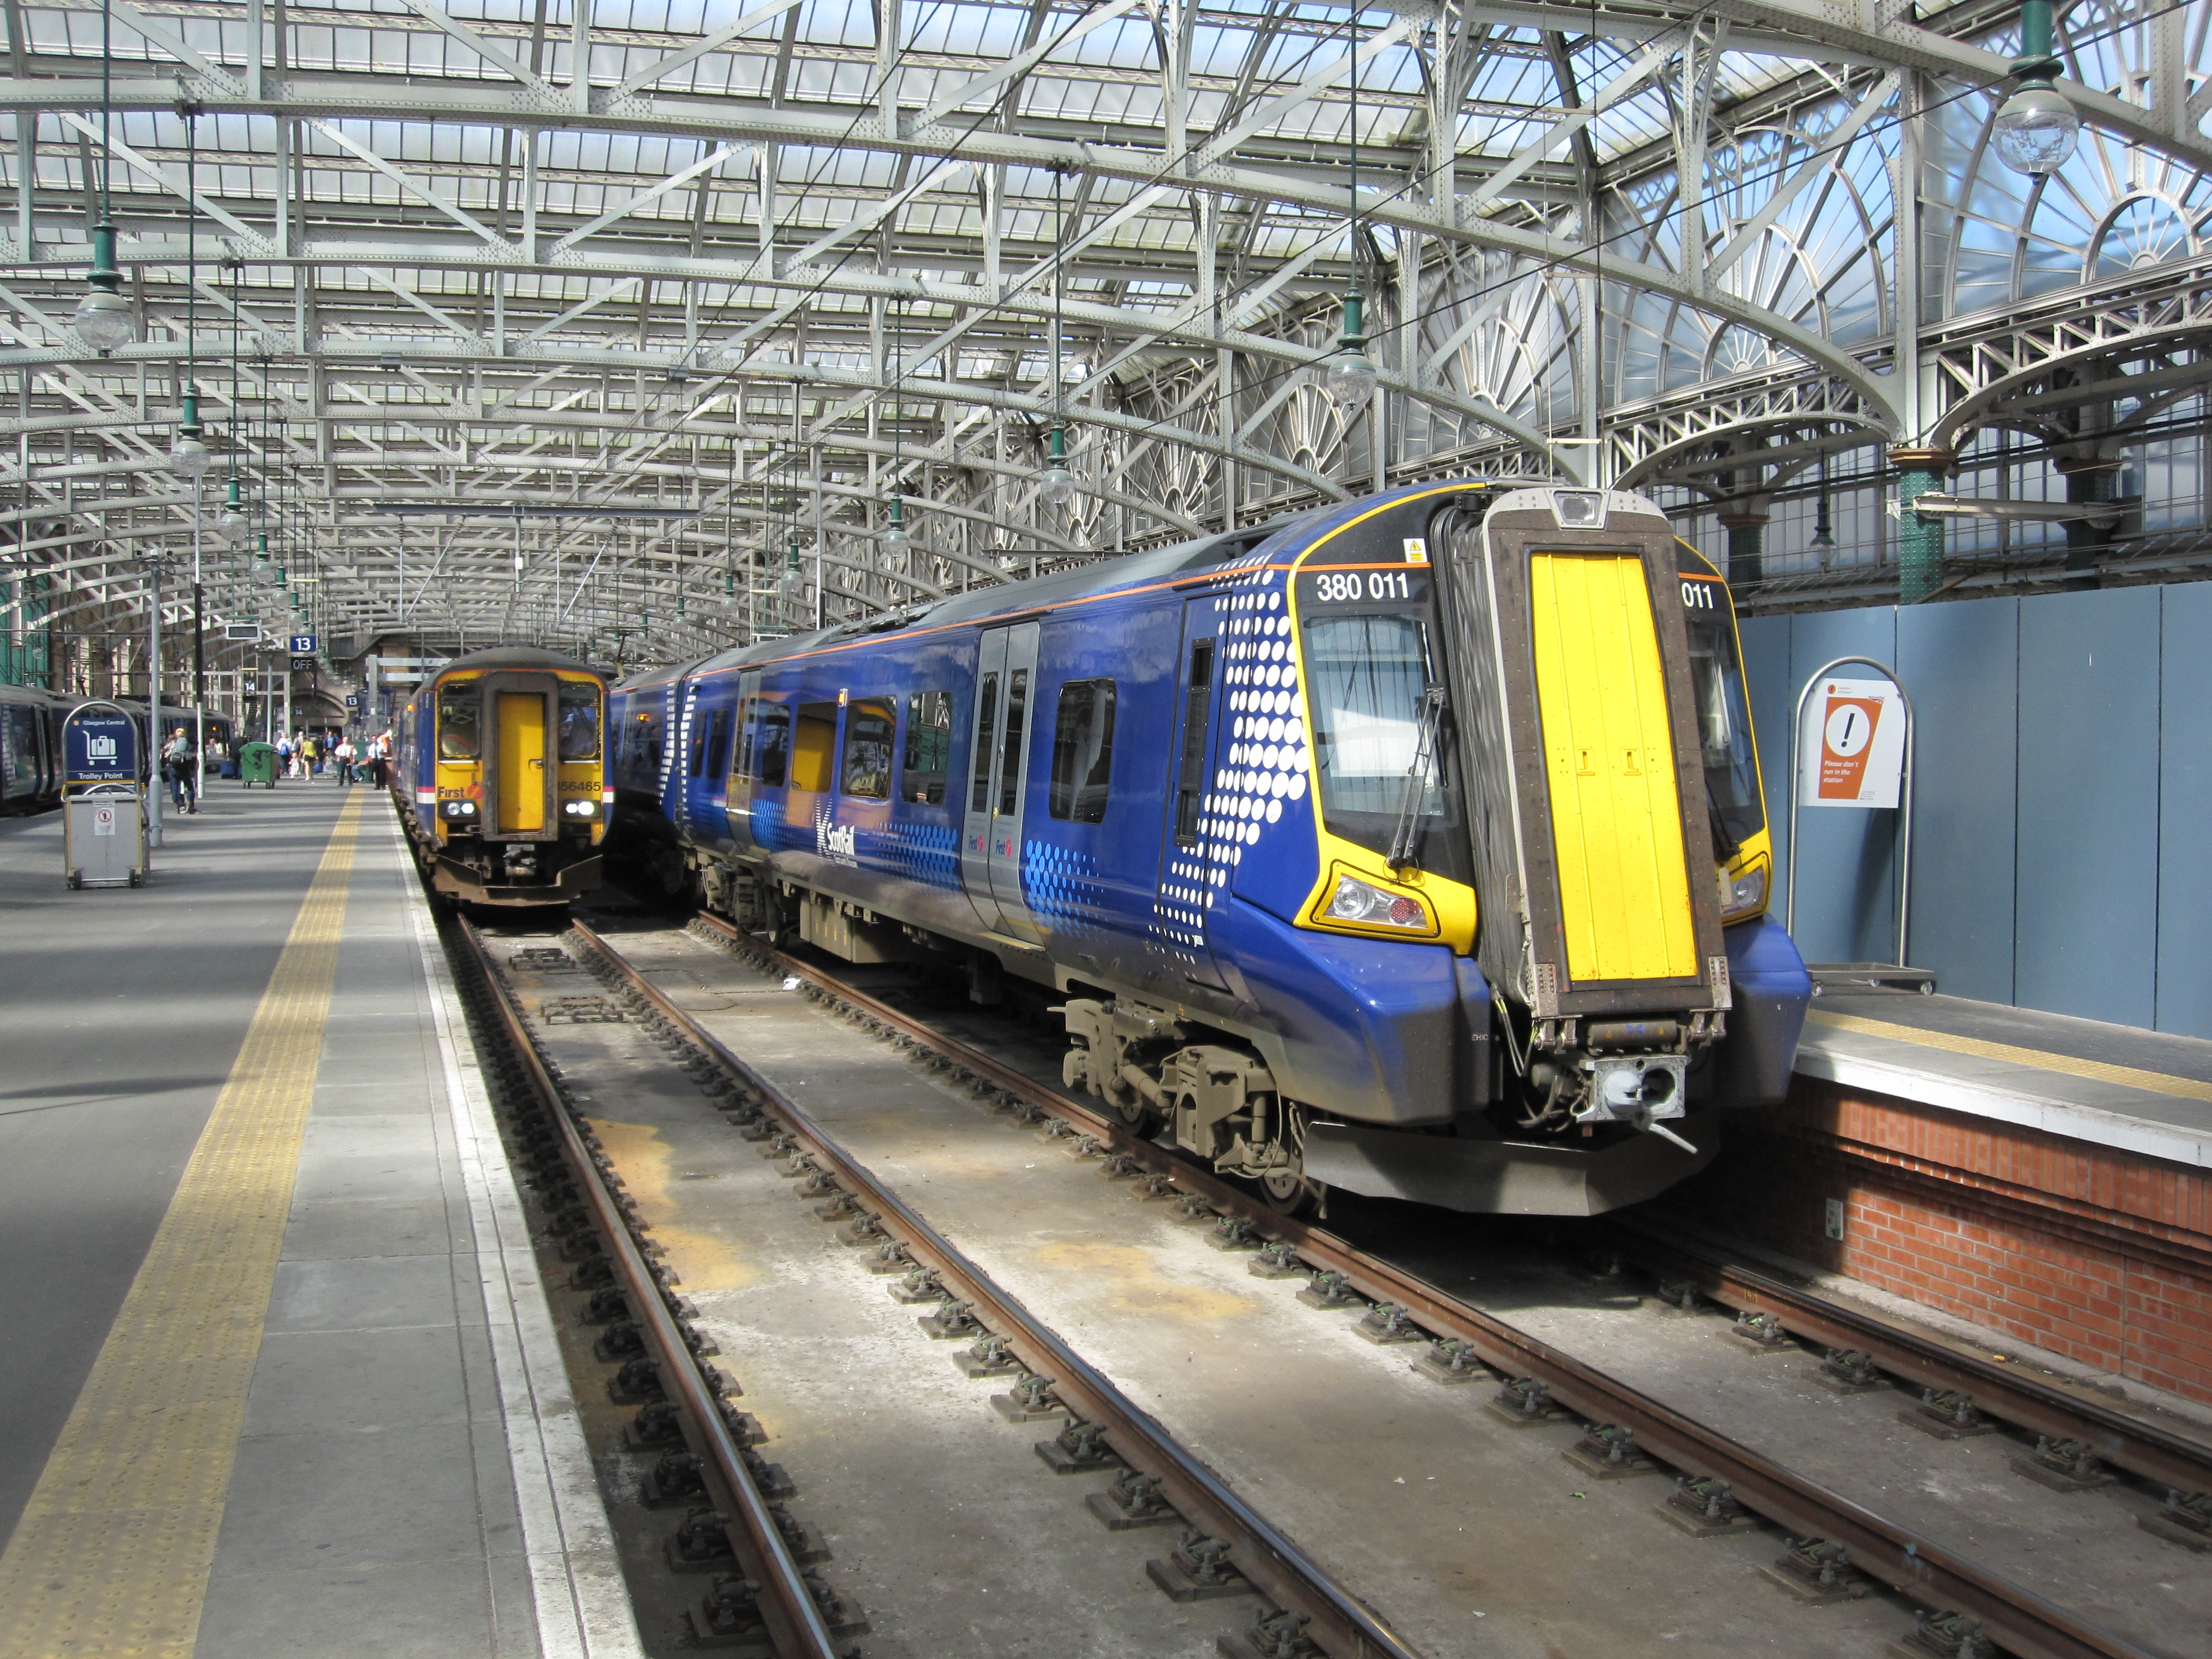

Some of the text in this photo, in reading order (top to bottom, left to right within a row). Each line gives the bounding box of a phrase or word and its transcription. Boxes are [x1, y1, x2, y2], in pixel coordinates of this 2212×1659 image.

[1316, 572, 1408, 601] 380 011
[1681, 582, 1713, 609] 011
[295, 638, 311, 651] 13
[293, 660, 312, 669] OFF
[244, 682, 255, 691] 14
[347, 697, 357, 706] 13
[438, 786, 465, 797] First
[827, 822, 855, 855] ScotRail
